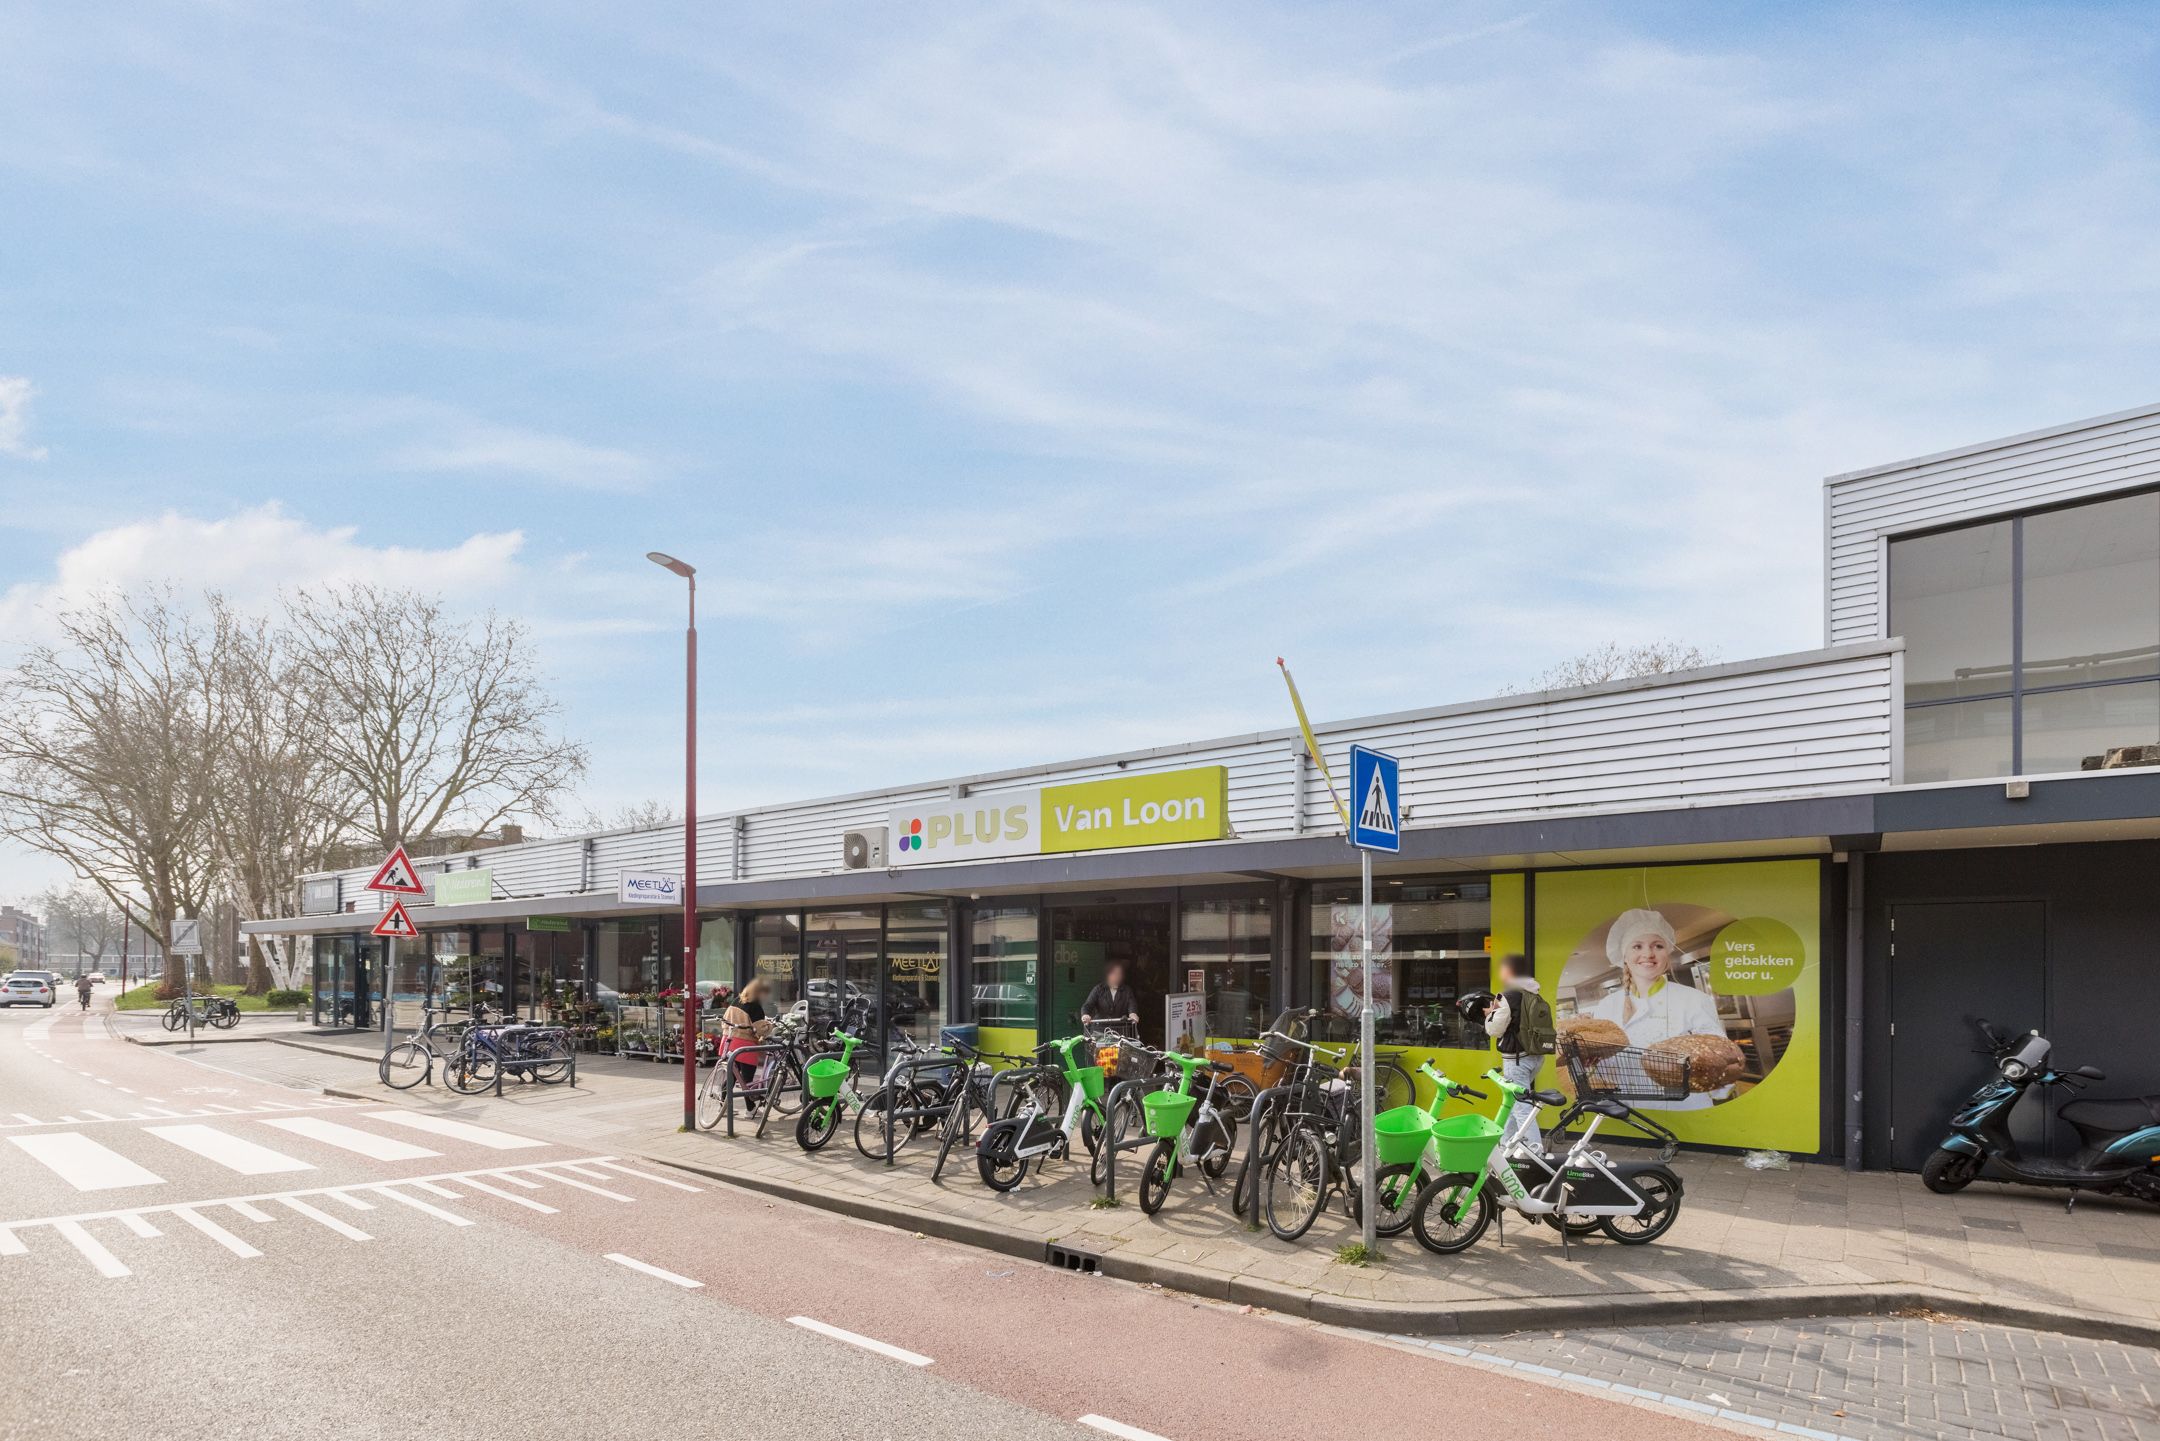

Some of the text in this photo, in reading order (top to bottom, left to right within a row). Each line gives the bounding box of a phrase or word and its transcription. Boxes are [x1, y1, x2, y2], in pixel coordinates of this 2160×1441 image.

[927, 796, 1205, 849] PLUS Van Loon
[627, 877, 676, 893] MEETLAT
[1725, 941, 1755, 952] Vers
[1725, 955, 1794, 968] gebakken
[1725, 971, 1774, 980] voor u.
[1186, 1000, 1202, 1012] 25%
[845, 1090, 861, 1110] Lime
[1567, 1170, 1595, 1178] LimeBike
[1501, 1167, 1525, 1200] Lime
